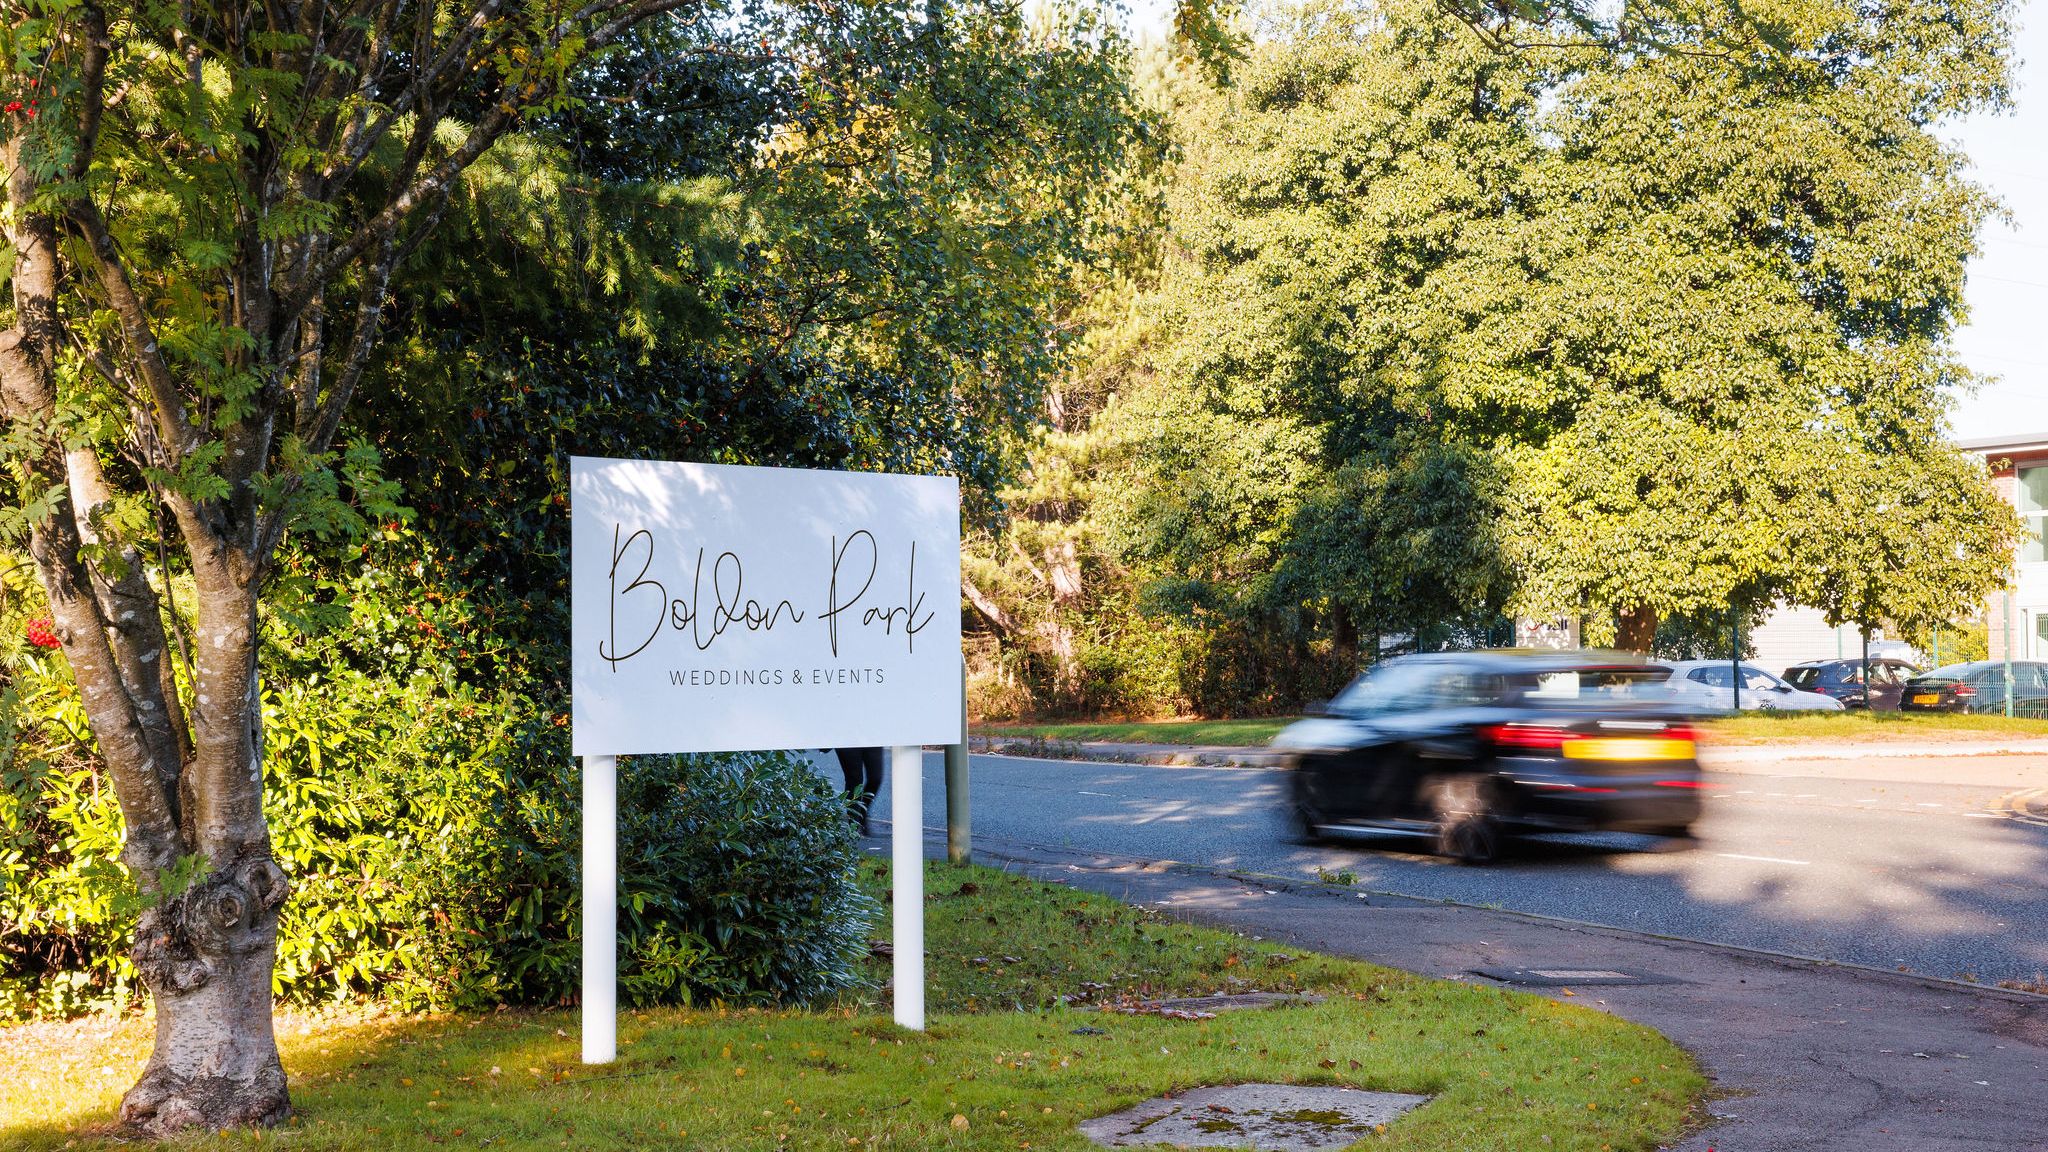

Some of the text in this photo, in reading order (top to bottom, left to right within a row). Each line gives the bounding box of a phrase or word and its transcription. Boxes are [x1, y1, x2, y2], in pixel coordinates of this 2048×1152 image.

[599, 522, 935, 674] Boldon Park
[669, 668, 884, 686] WEDDINGS & EVENTS
